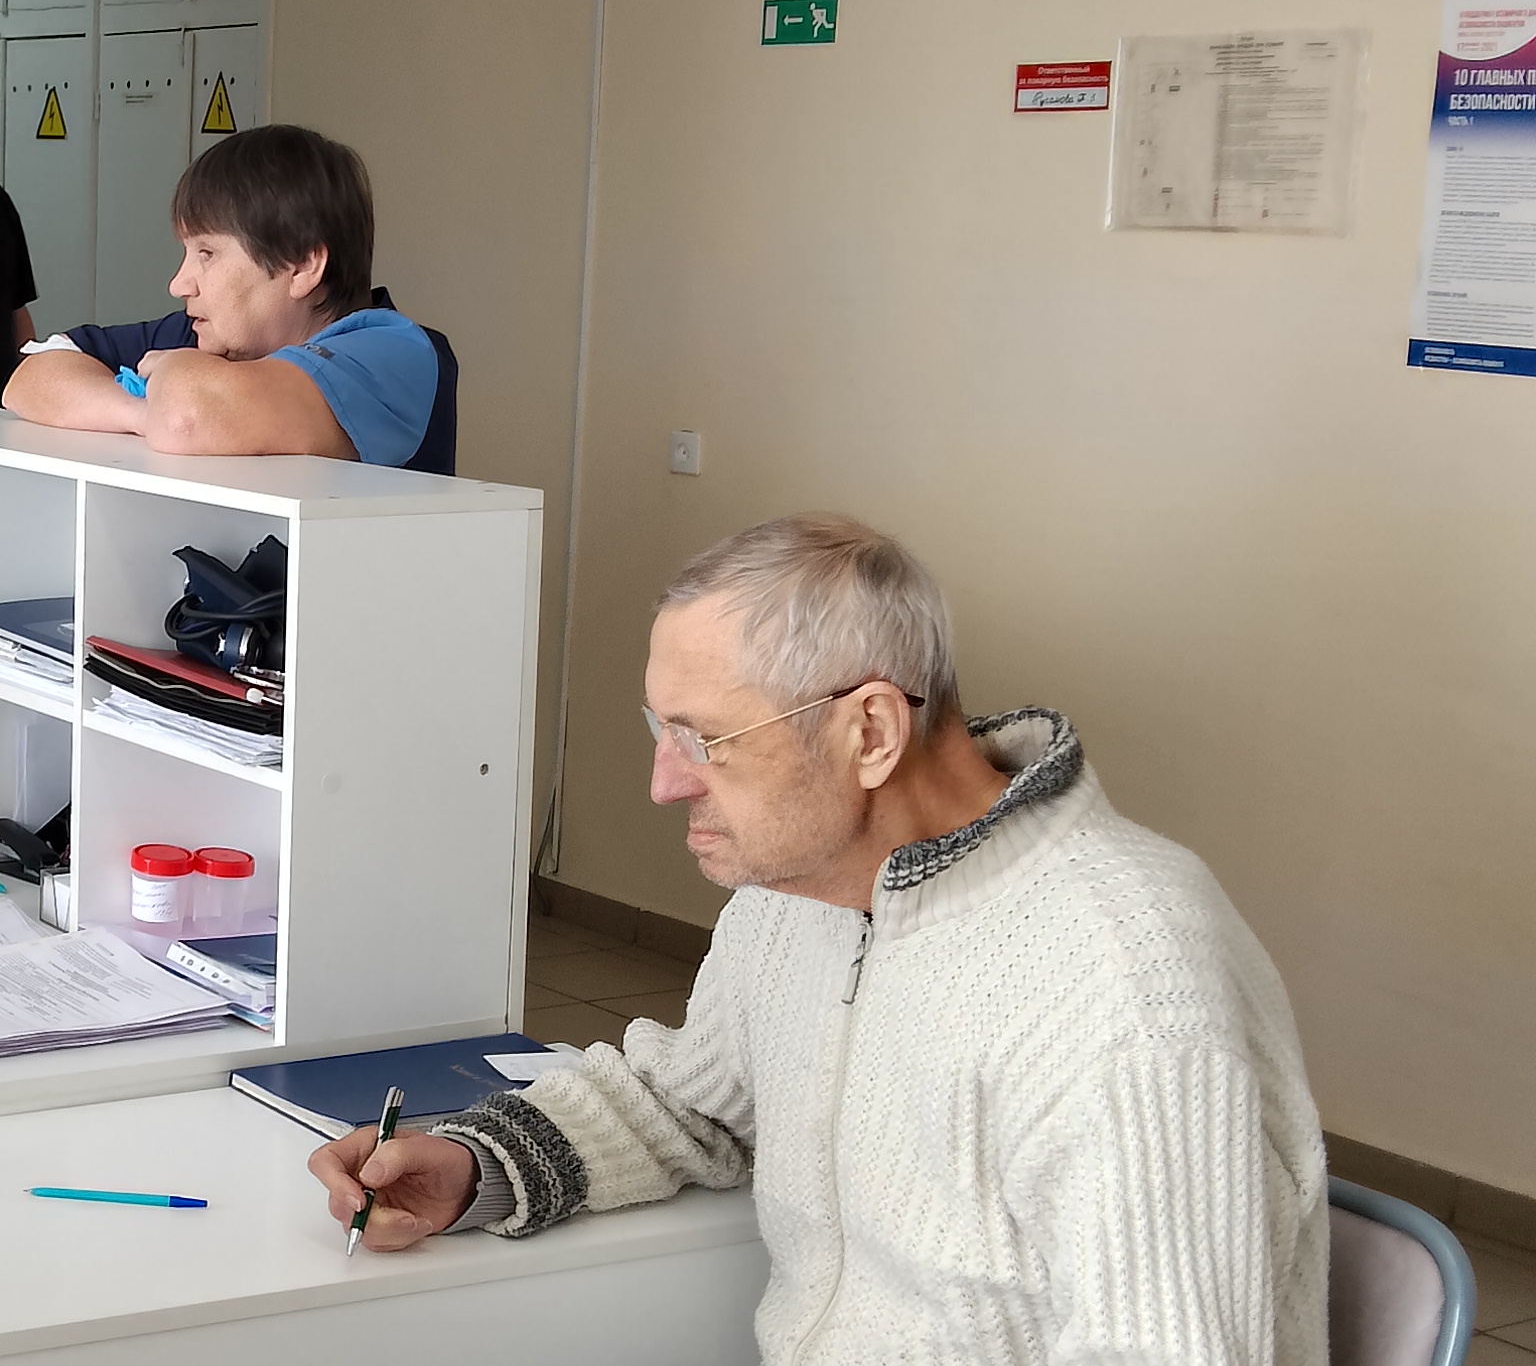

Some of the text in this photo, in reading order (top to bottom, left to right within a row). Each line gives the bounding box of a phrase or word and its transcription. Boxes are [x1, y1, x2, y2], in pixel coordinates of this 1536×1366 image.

[1454, 68, 1469, 86] 10
[1469, 69, 1526, 86] ГЛАВНЫХ
[1449, 93, 1536, 111] БЕЗОПАСНОСТИ
